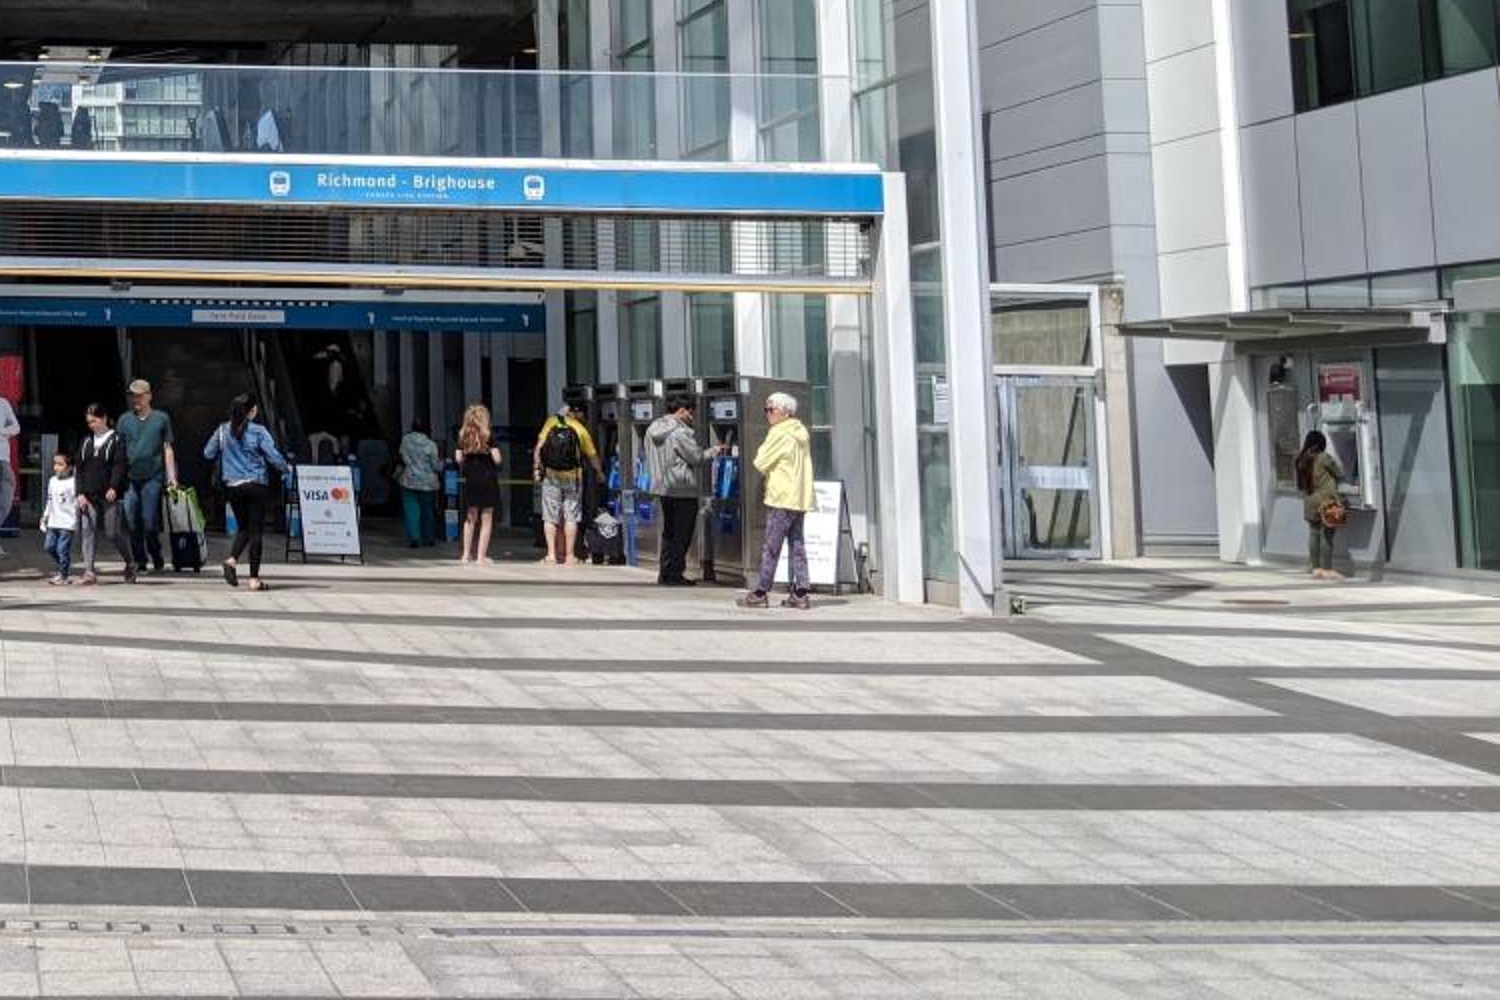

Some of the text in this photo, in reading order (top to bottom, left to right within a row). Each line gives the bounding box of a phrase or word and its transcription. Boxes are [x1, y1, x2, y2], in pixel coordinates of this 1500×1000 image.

[316, 173, 397, 188] Richmond
[413, 174, 496, 193] Brighouse
[303, 489, 329, 501] VISA
